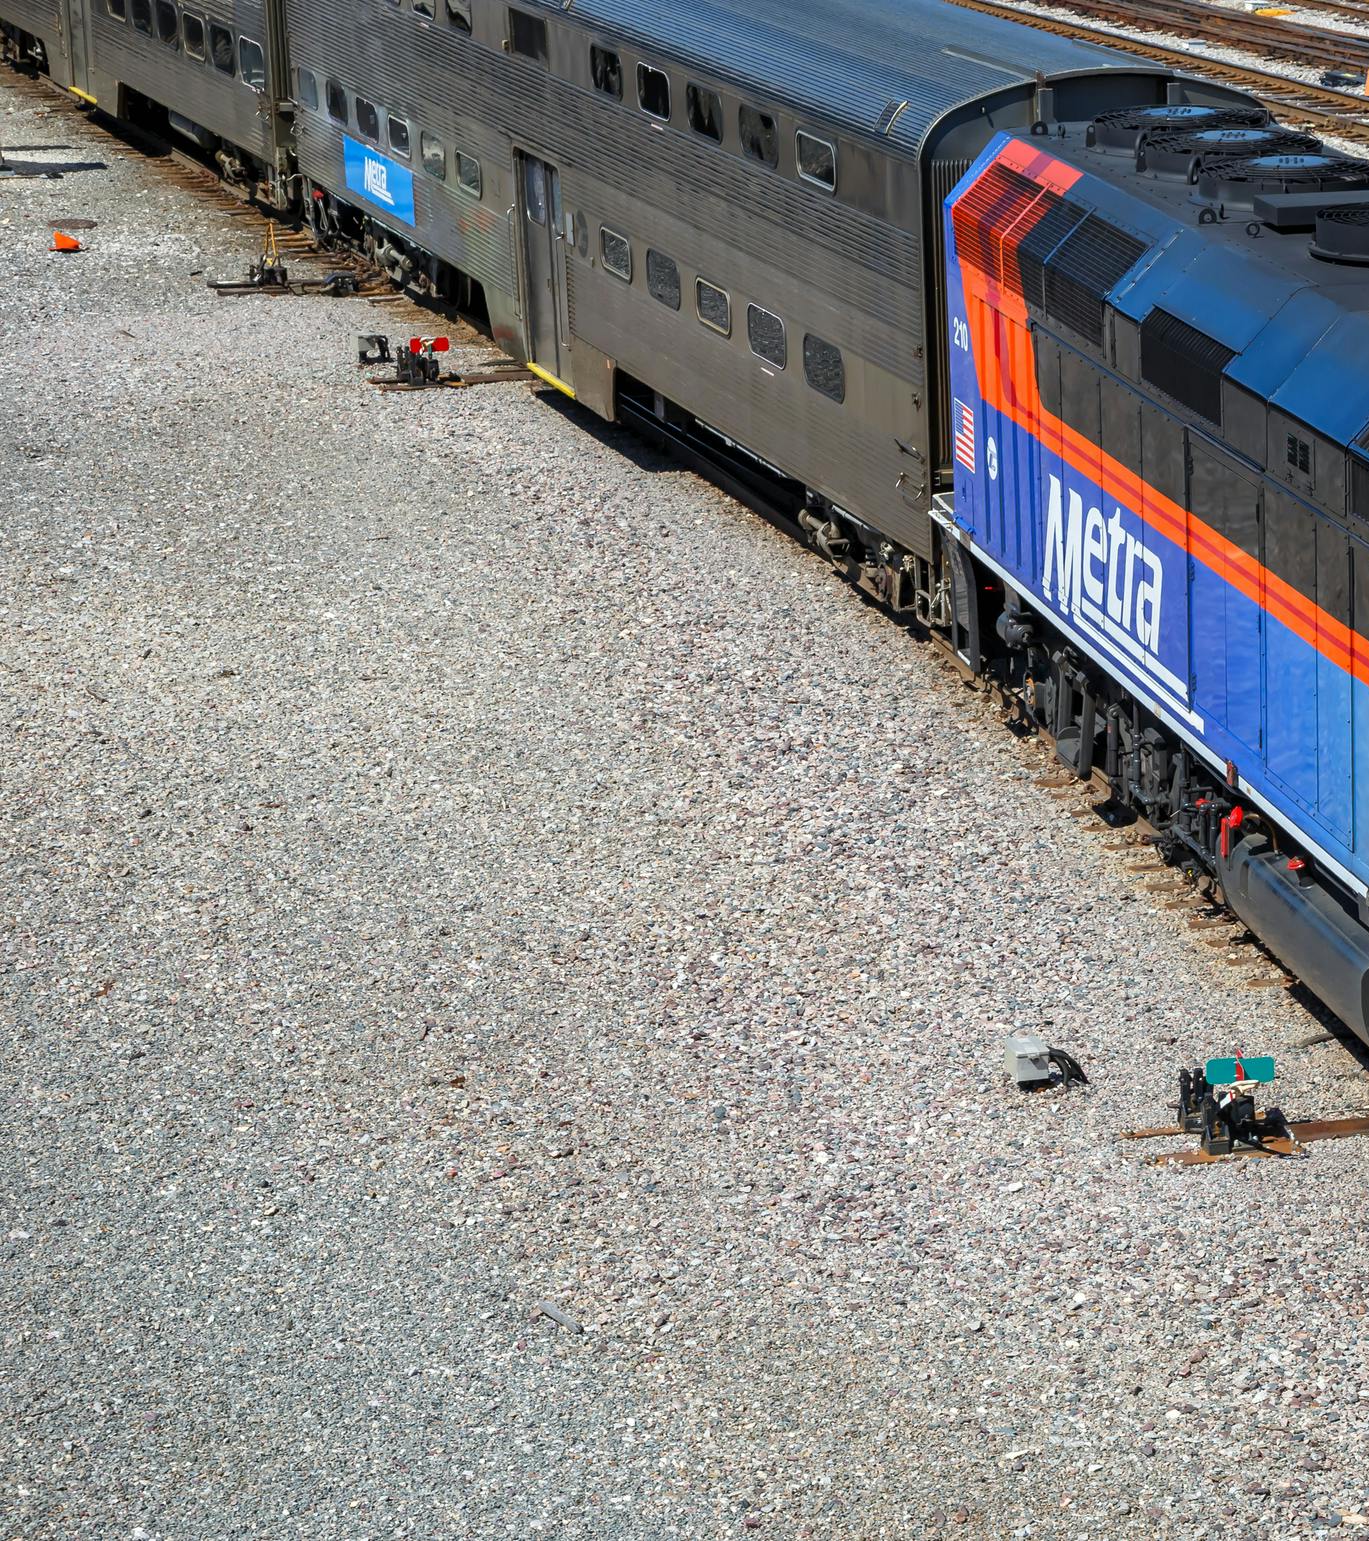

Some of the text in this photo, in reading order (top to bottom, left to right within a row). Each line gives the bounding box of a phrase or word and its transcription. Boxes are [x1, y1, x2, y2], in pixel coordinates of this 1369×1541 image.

[364, 156, 387, 192] Metra
[953, 316, 969, 353] 210
[1042, 473, 1164, 657] Metra
